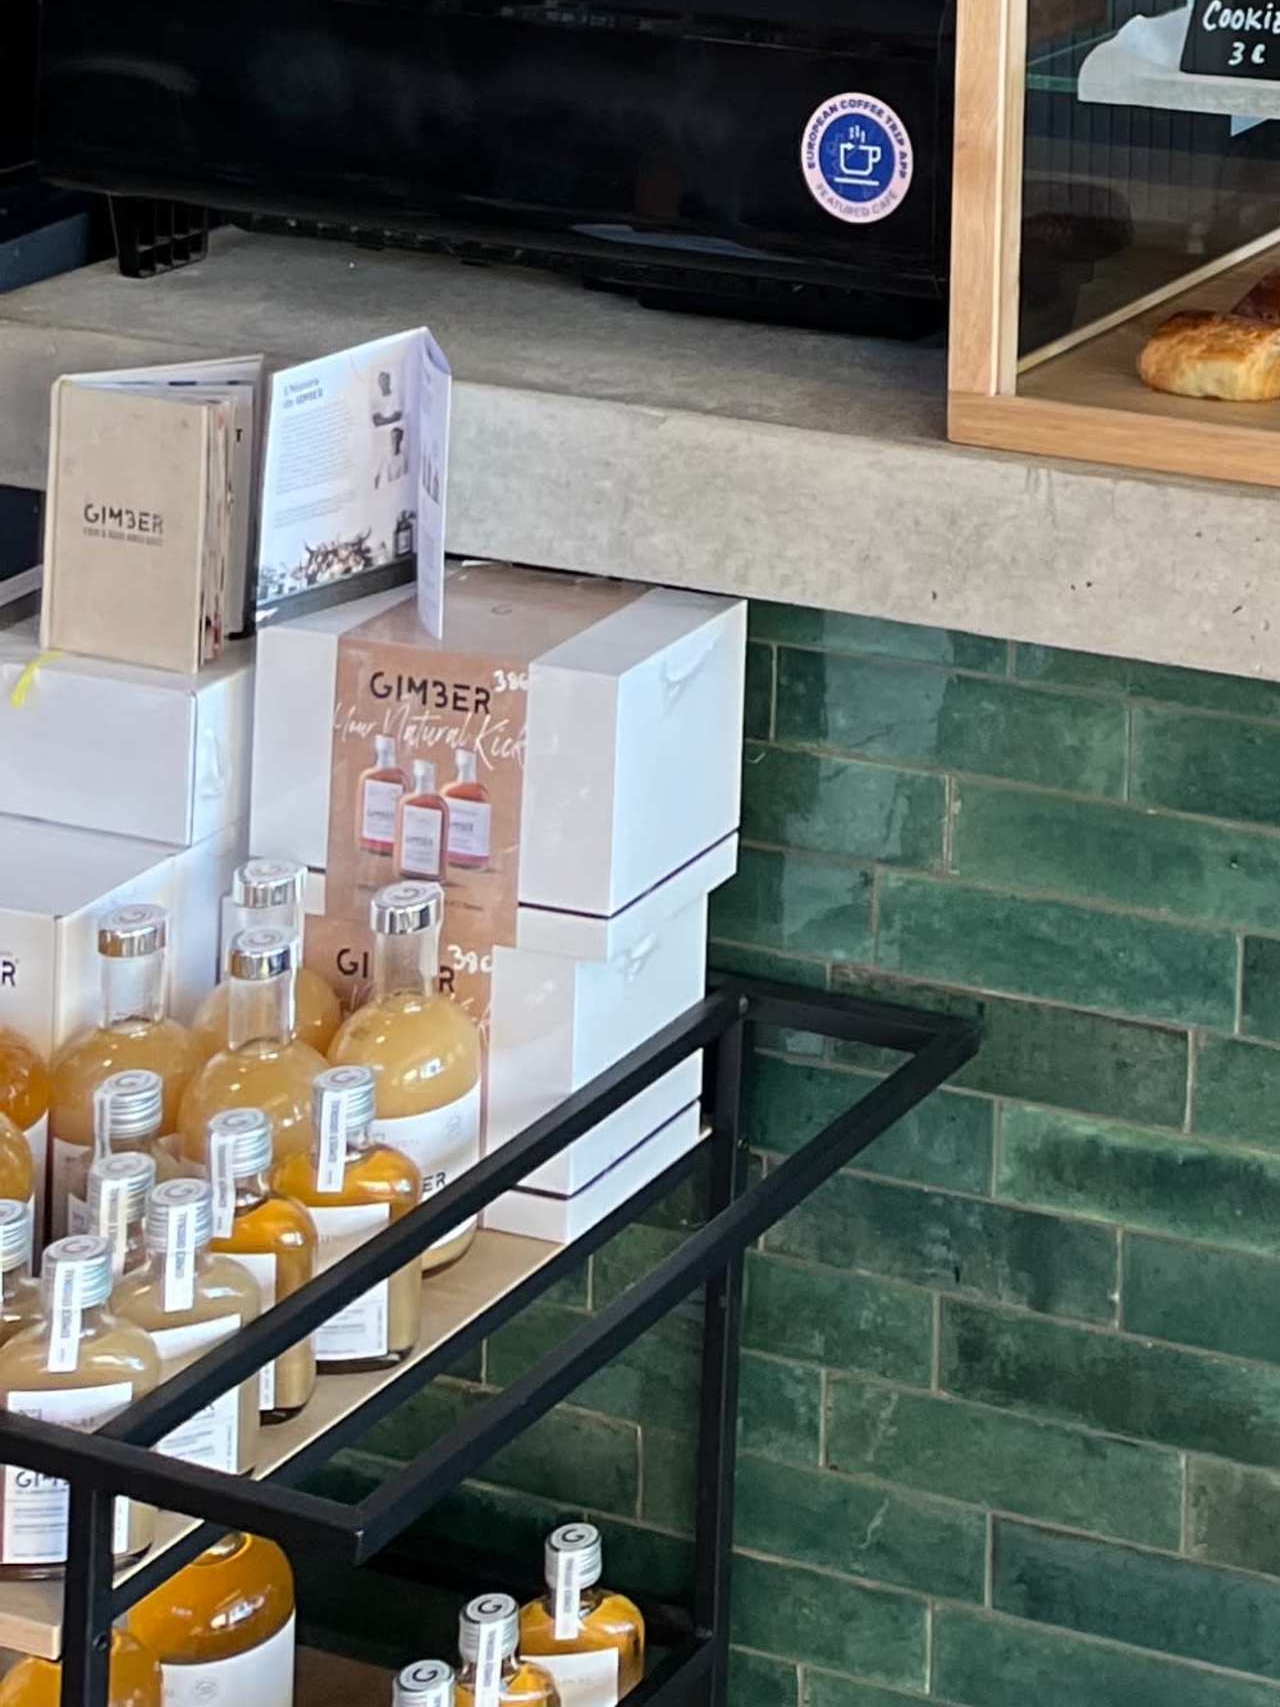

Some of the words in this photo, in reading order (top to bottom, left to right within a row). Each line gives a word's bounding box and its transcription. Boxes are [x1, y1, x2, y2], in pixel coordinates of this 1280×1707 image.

[807, 104, 839, 171] EUROPEAN
[840, 98, 886, 119] COFFEE
[886, 114, 907, 156] TRIP
[897, 150, 909, 180] APP
[383, 703, 472, 755] Natural
